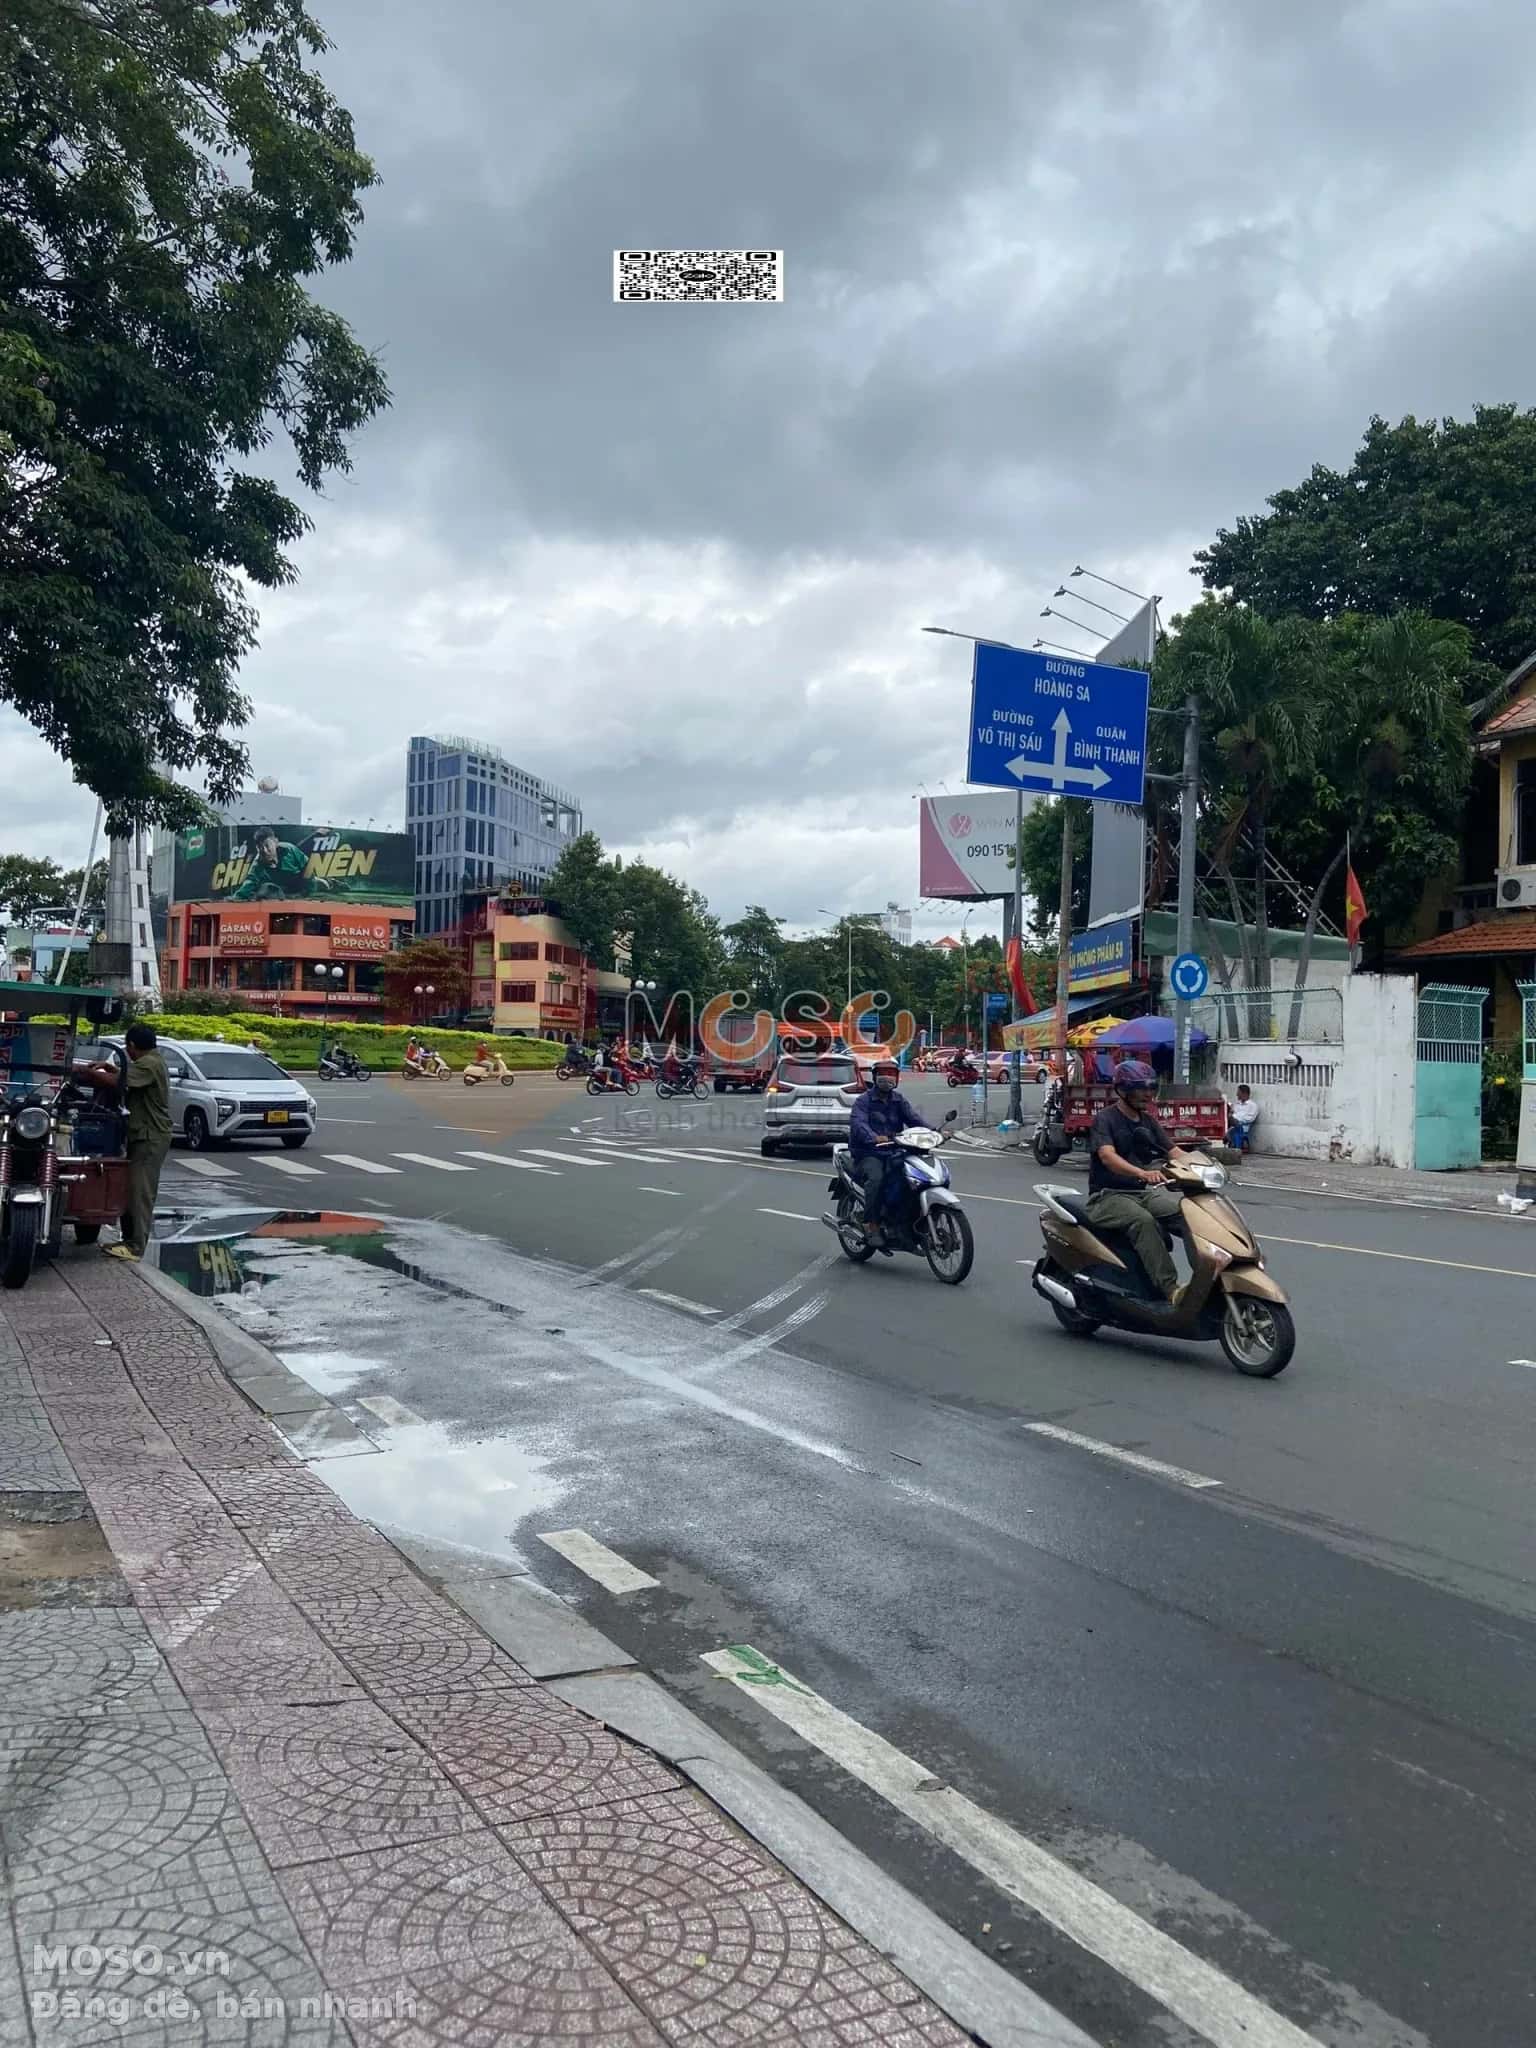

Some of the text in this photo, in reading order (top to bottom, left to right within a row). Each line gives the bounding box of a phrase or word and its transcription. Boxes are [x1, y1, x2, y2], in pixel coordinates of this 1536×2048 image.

[1046, 660, 1085, 678] ĐƯỜNG
[1034, 677, 1090, 702] HOÀNG SA
[992, 709, 1034, 727] ĐƯỜNG
[978, 726, 1042, 752] VÕ THỊ SÁU
[1096, 726, 1126, 742] QUẬN
[1074, 738, 1140, 766] BÌNH THẠNH
[230, 840, 248, 860] CÓ
[313, 831, 340, 851] THÌ
[304, 844, 377, 879] NÊN
[967, 845, 990, 858] 090
[333, 924, 370, 936] GÀ RÁN
